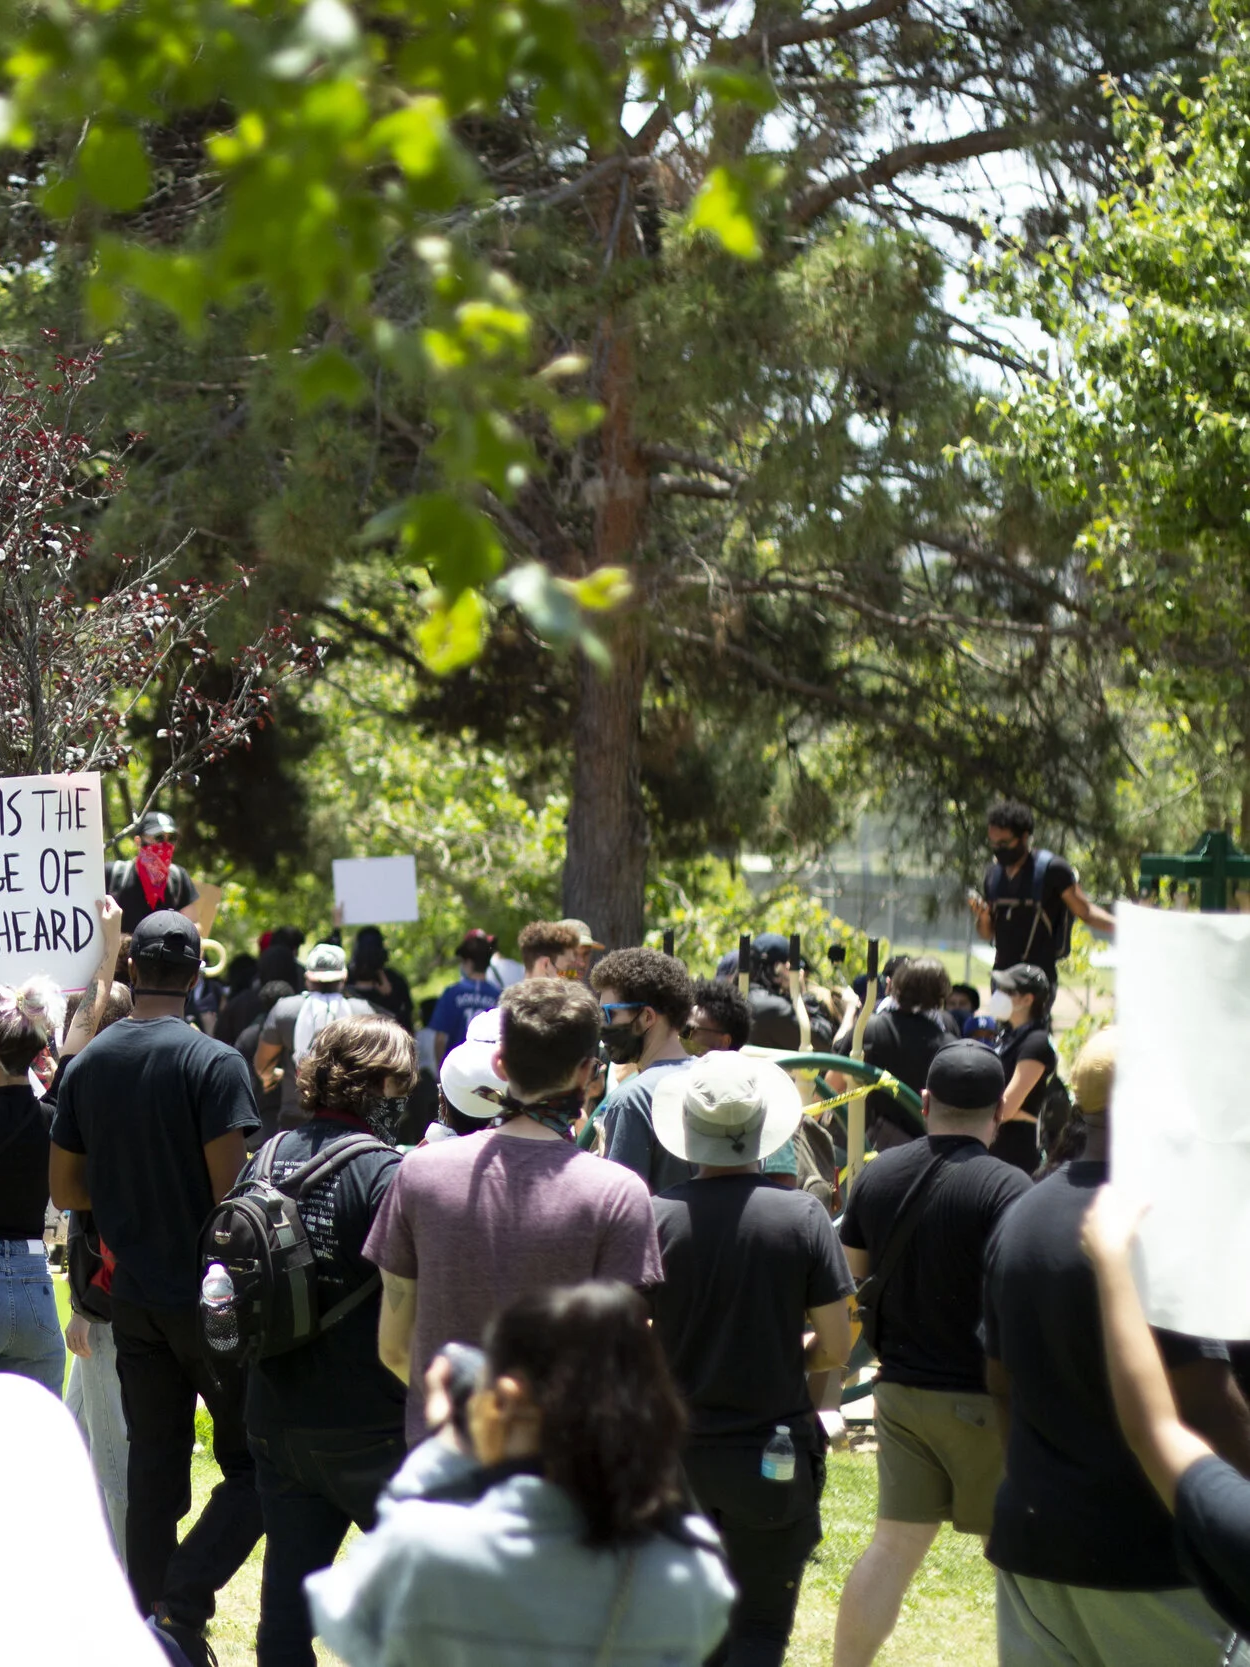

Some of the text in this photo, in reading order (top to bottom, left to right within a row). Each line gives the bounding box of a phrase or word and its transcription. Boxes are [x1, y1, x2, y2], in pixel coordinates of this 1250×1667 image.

[0, 789, 22, 837] IS
[32, 788, 90, 832] THE
[39, 848, 86, 896] OF
